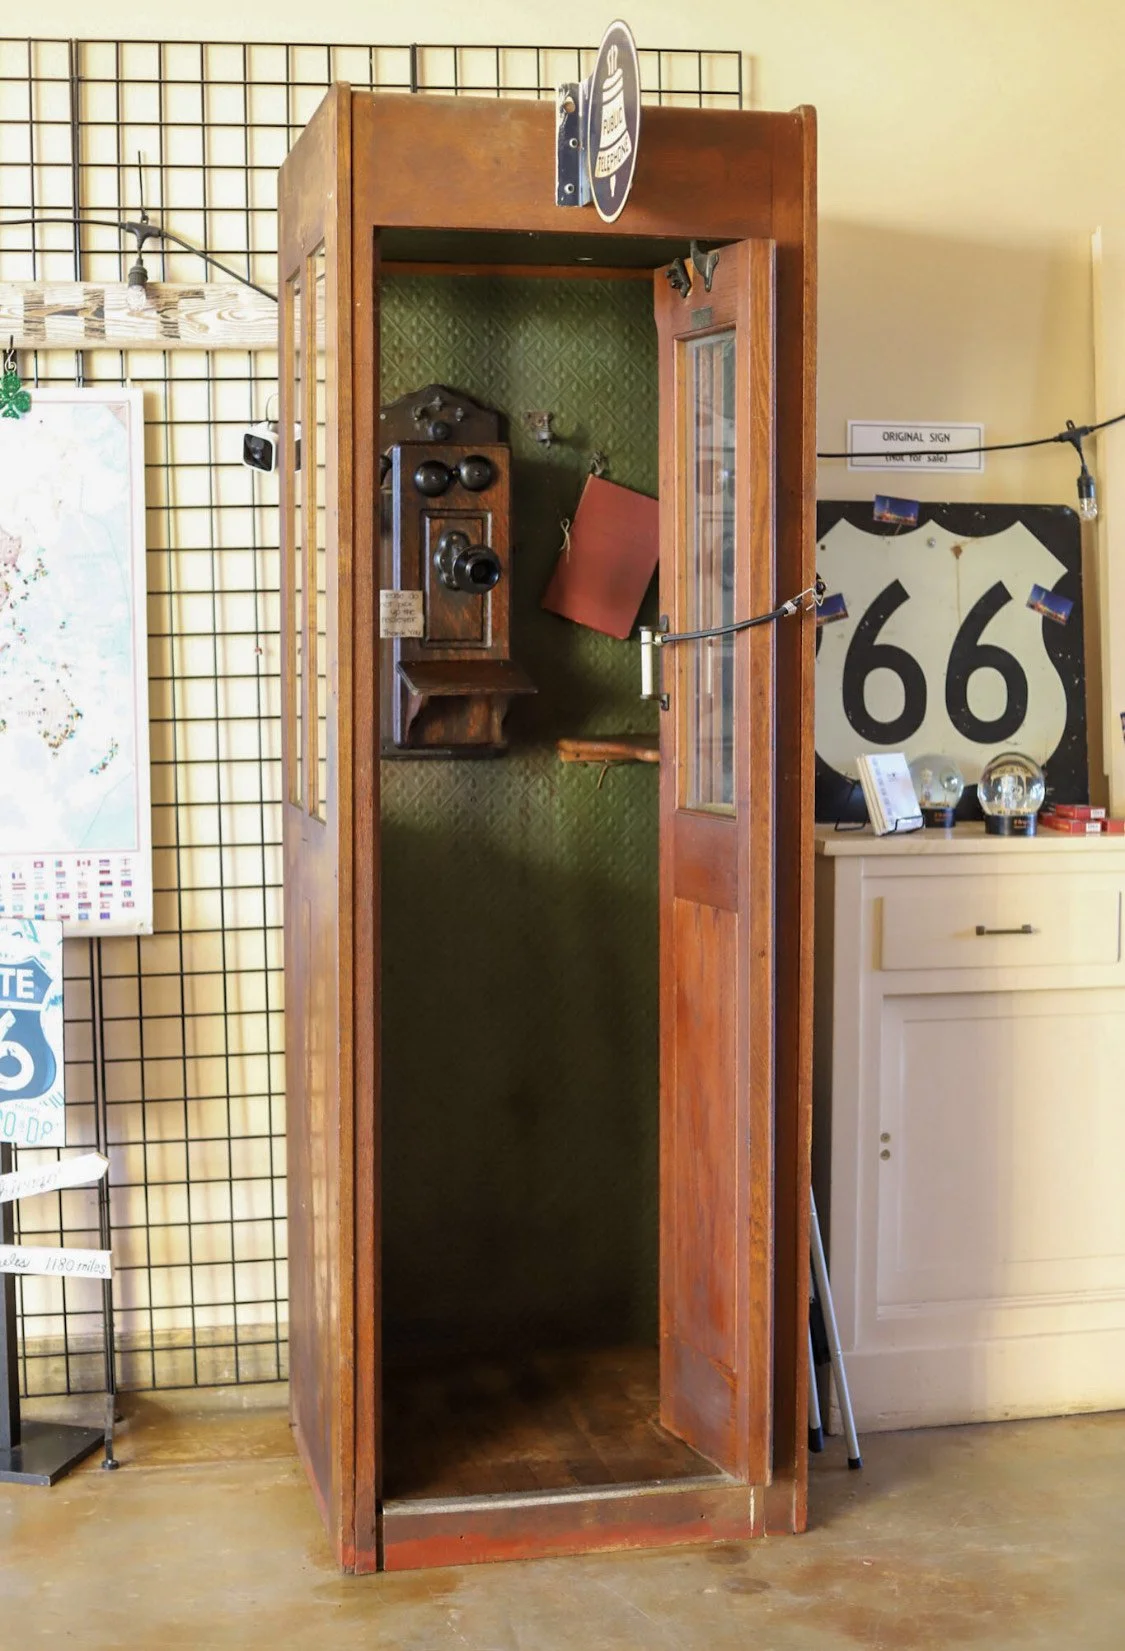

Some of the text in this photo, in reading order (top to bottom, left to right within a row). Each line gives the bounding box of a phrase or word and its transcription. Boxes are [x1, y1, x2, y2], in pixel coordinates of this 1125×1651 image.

[602, 107, 624, 135] PUBLIC
[598, 135, 630, 173] TELEPHONE
[882, 431, 951, 443] ORIGINAL SIGN
[927, 452, 948, 463] sale)
[842, 578, 1029, 746] 66
[45, 1256, 75, 1272] 1180
[76, 1259, 107, 1275] miles
